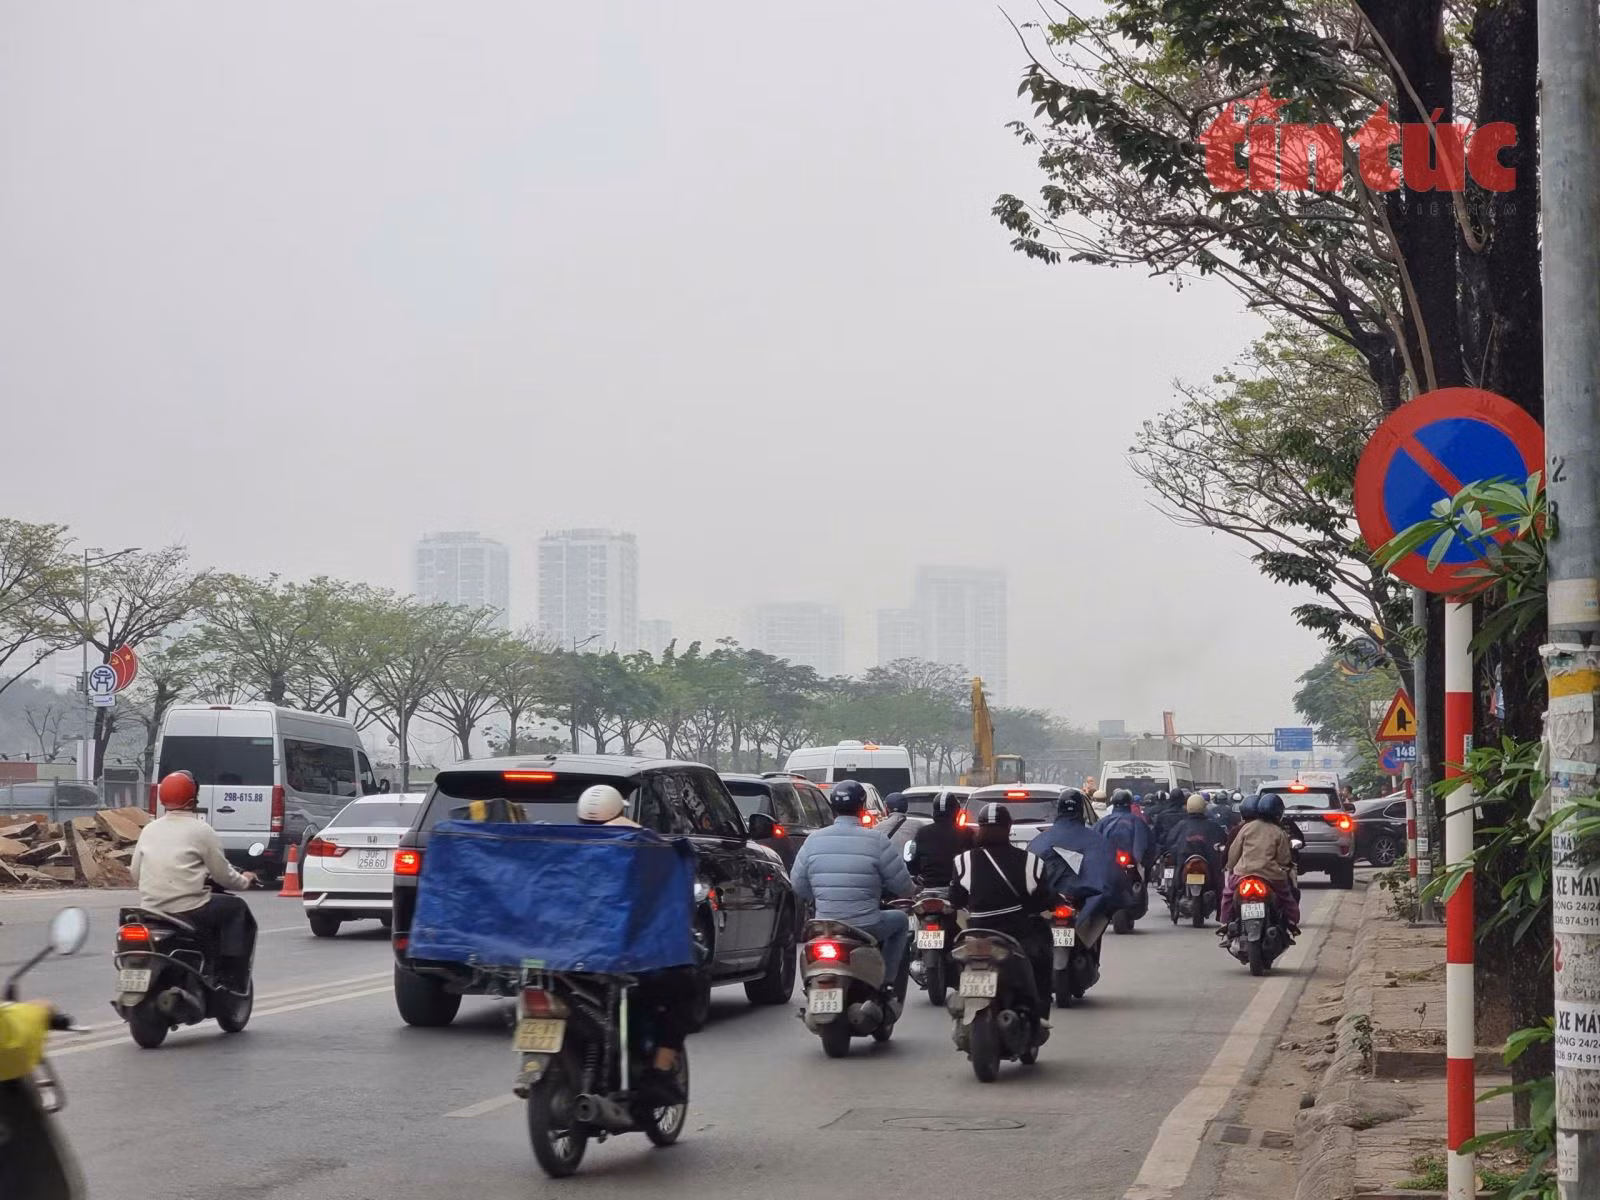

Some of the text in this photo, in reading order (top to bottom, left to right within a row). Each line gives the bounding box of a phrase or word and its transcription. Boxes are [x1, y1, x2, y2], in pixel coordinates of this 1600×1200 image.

[1395, 746, 1416, 757] 148
[224, 792, 263, 802] 29B-615.88
[1556, 876, 1568, 896] XE
[1559, 1010, 1600, 1034] XE MÁ
